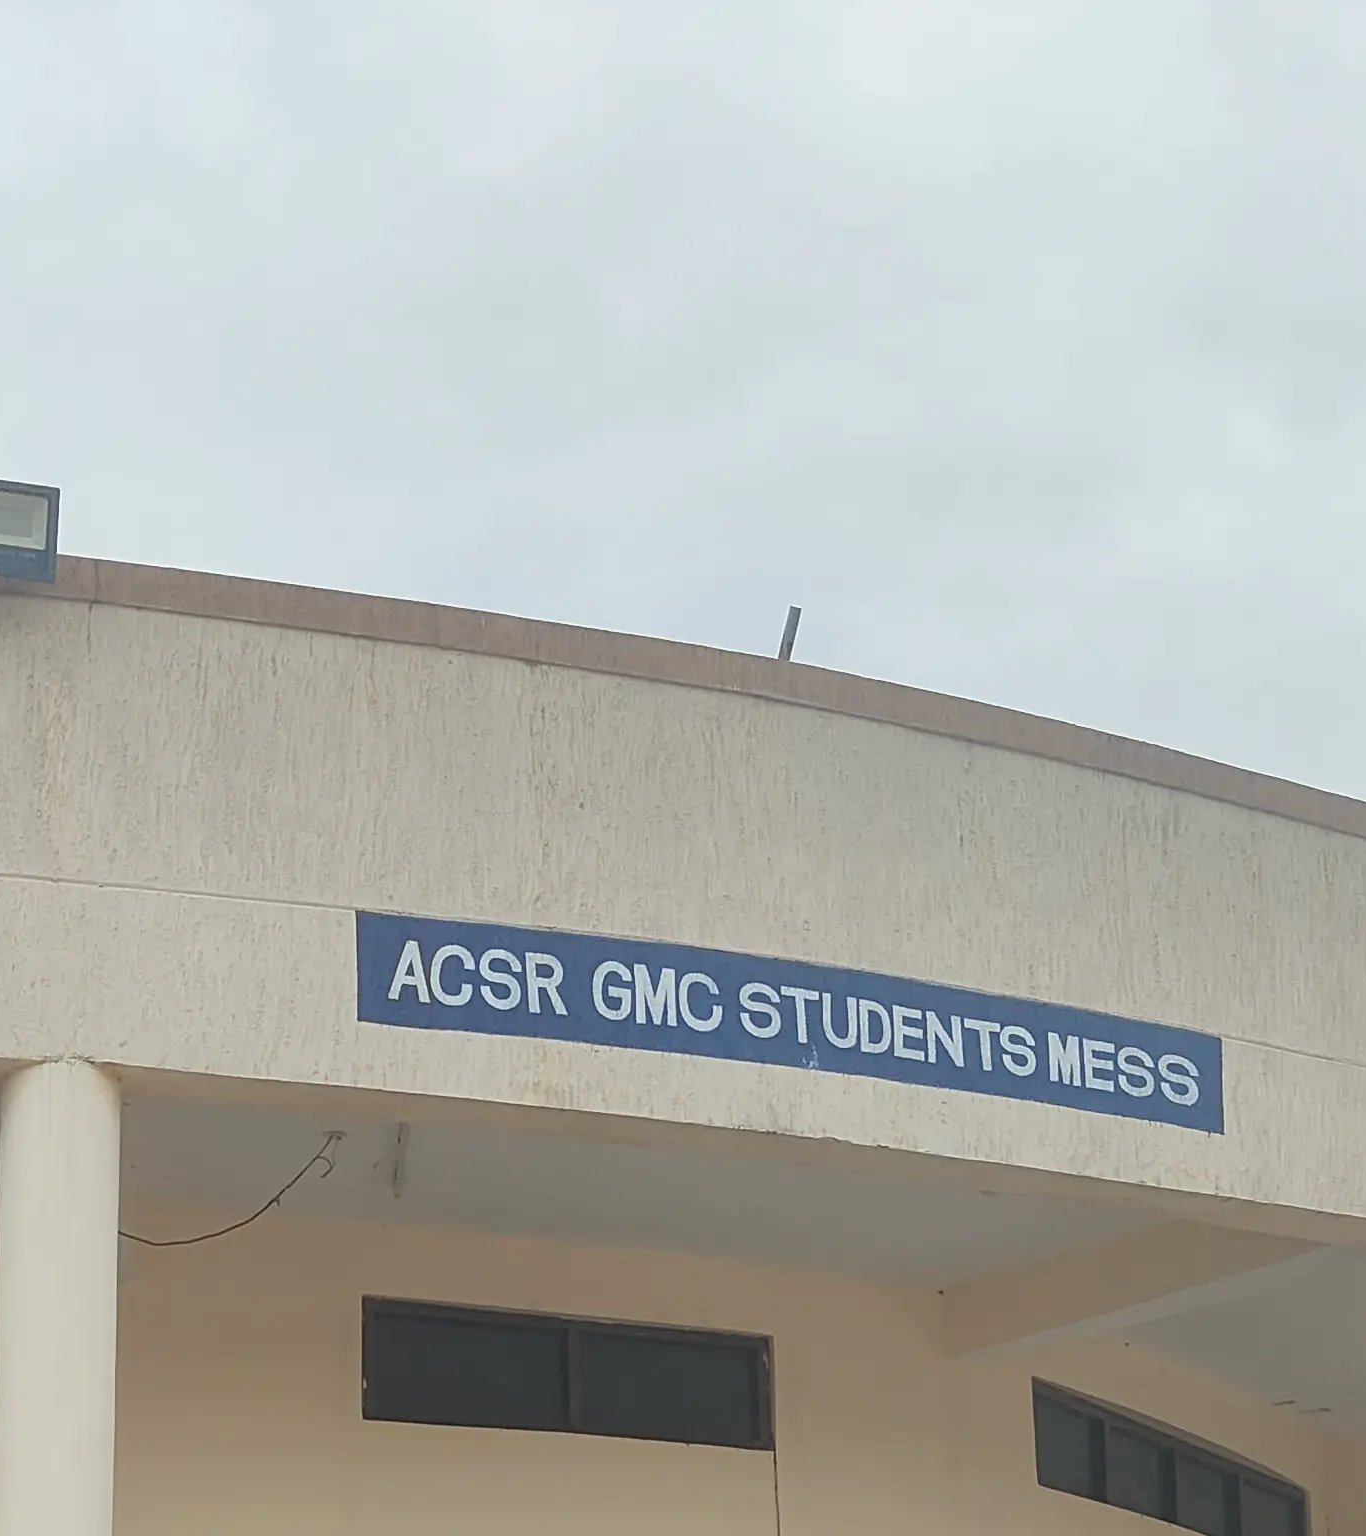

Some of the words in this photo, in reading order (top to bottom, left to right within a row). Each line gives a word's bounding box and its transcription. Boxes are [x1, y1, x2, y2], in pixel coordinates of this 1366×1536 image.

[388, 940, 568, 1016] ACSR
[592, 960, 724, 1033] GMC
[739, 981, 1036, 1077] STUDENTS
[1047, 1031, 1201, 1107] MESS
